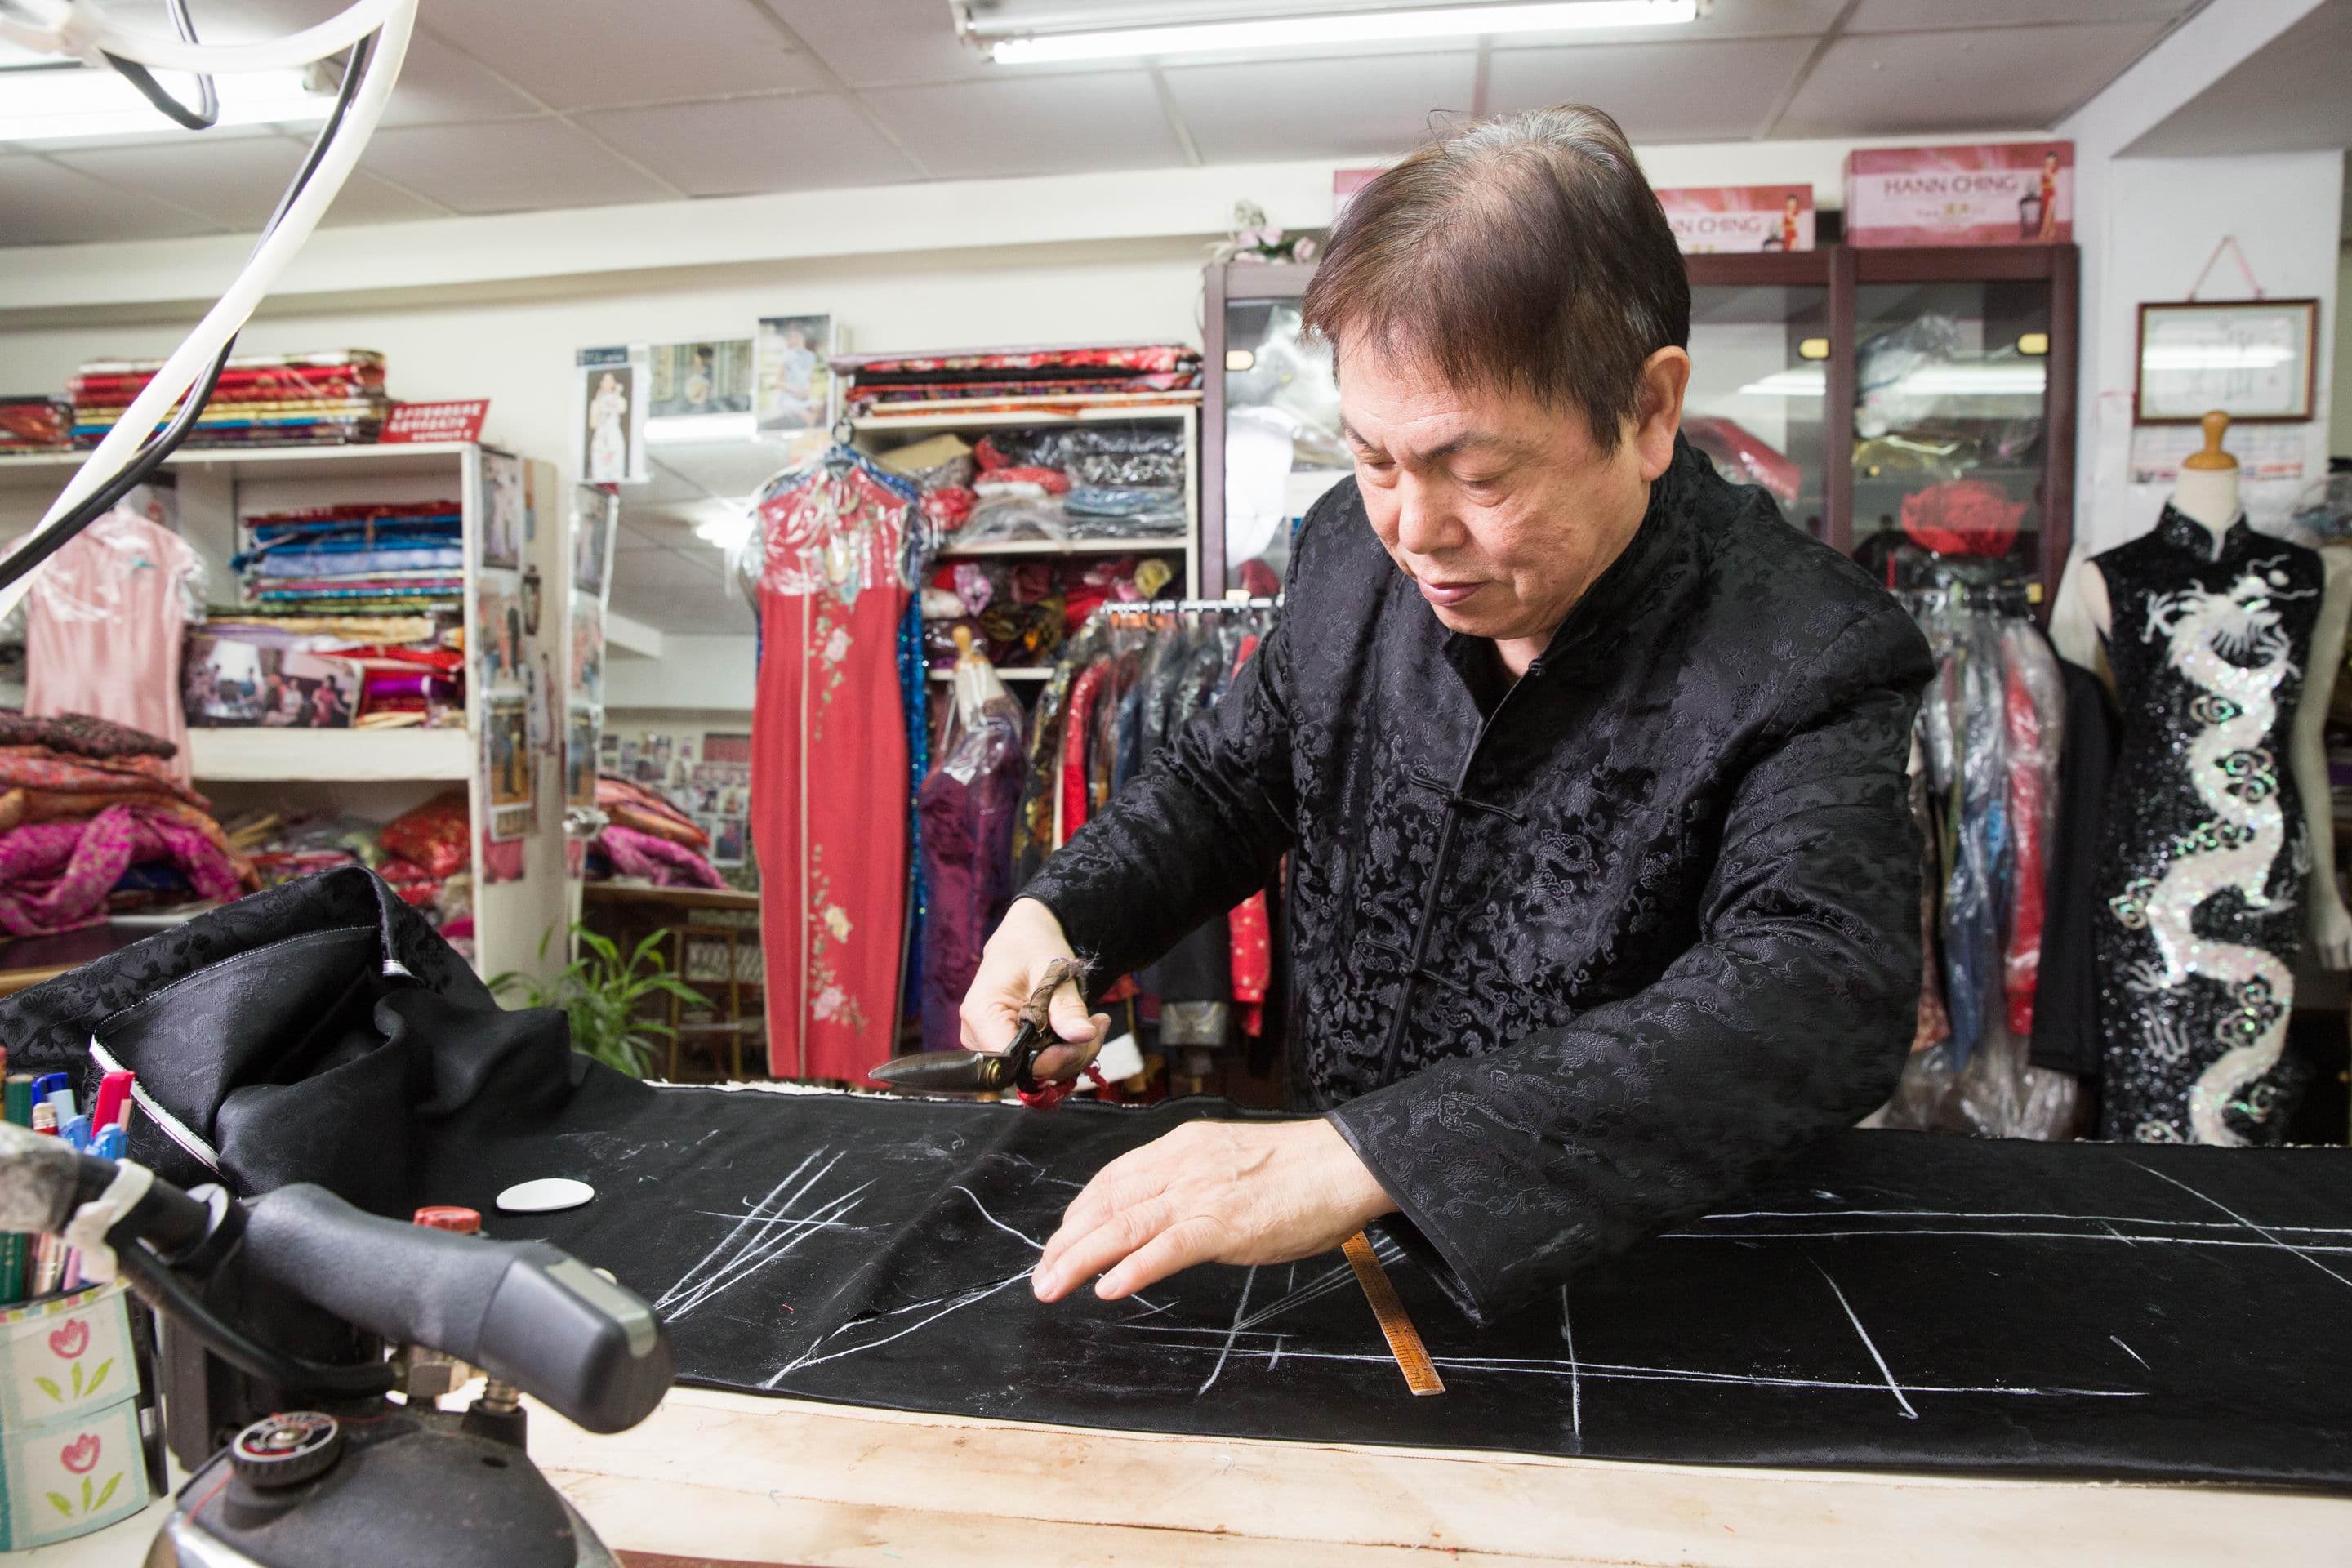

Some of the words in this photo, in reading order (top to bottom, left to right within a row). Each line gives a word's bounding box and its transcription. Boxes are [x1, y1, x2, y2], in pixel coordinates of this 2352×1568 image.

[1883, 176, 1948, 197] HANN
[1951, 174, 2019, 194] CHING
[1697, 216, 1762, 234] CHING
